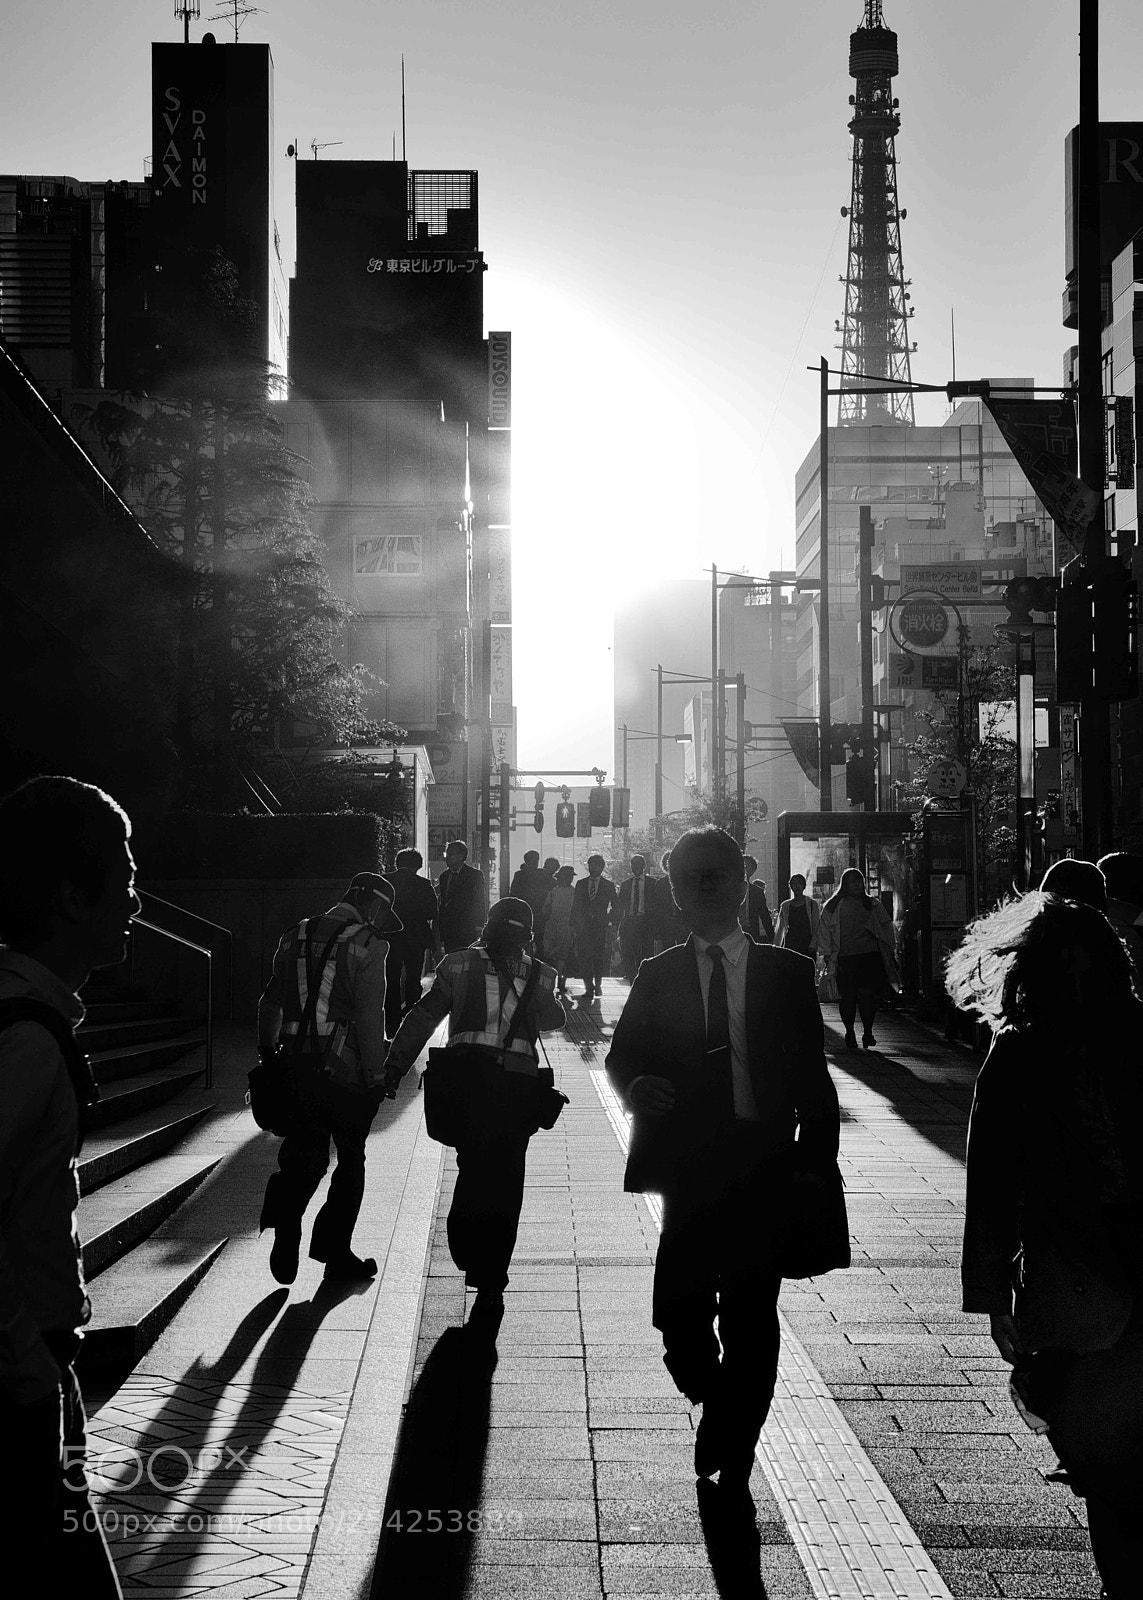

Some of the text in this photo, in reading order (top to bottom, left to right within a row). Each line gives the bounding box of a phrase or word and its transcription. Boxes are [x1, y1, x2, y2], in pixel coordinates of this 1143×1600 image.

[162, 86, 182, 188] SVAX
[192, 109, 207, 204] DAIMON
[386, 258, 479, 273] 東京ビルグループ
[491, 334, 509, 423] JOYSOUND
[940, 584, 960, 592] Center
[904, 612, 945, 632] 消火栓
